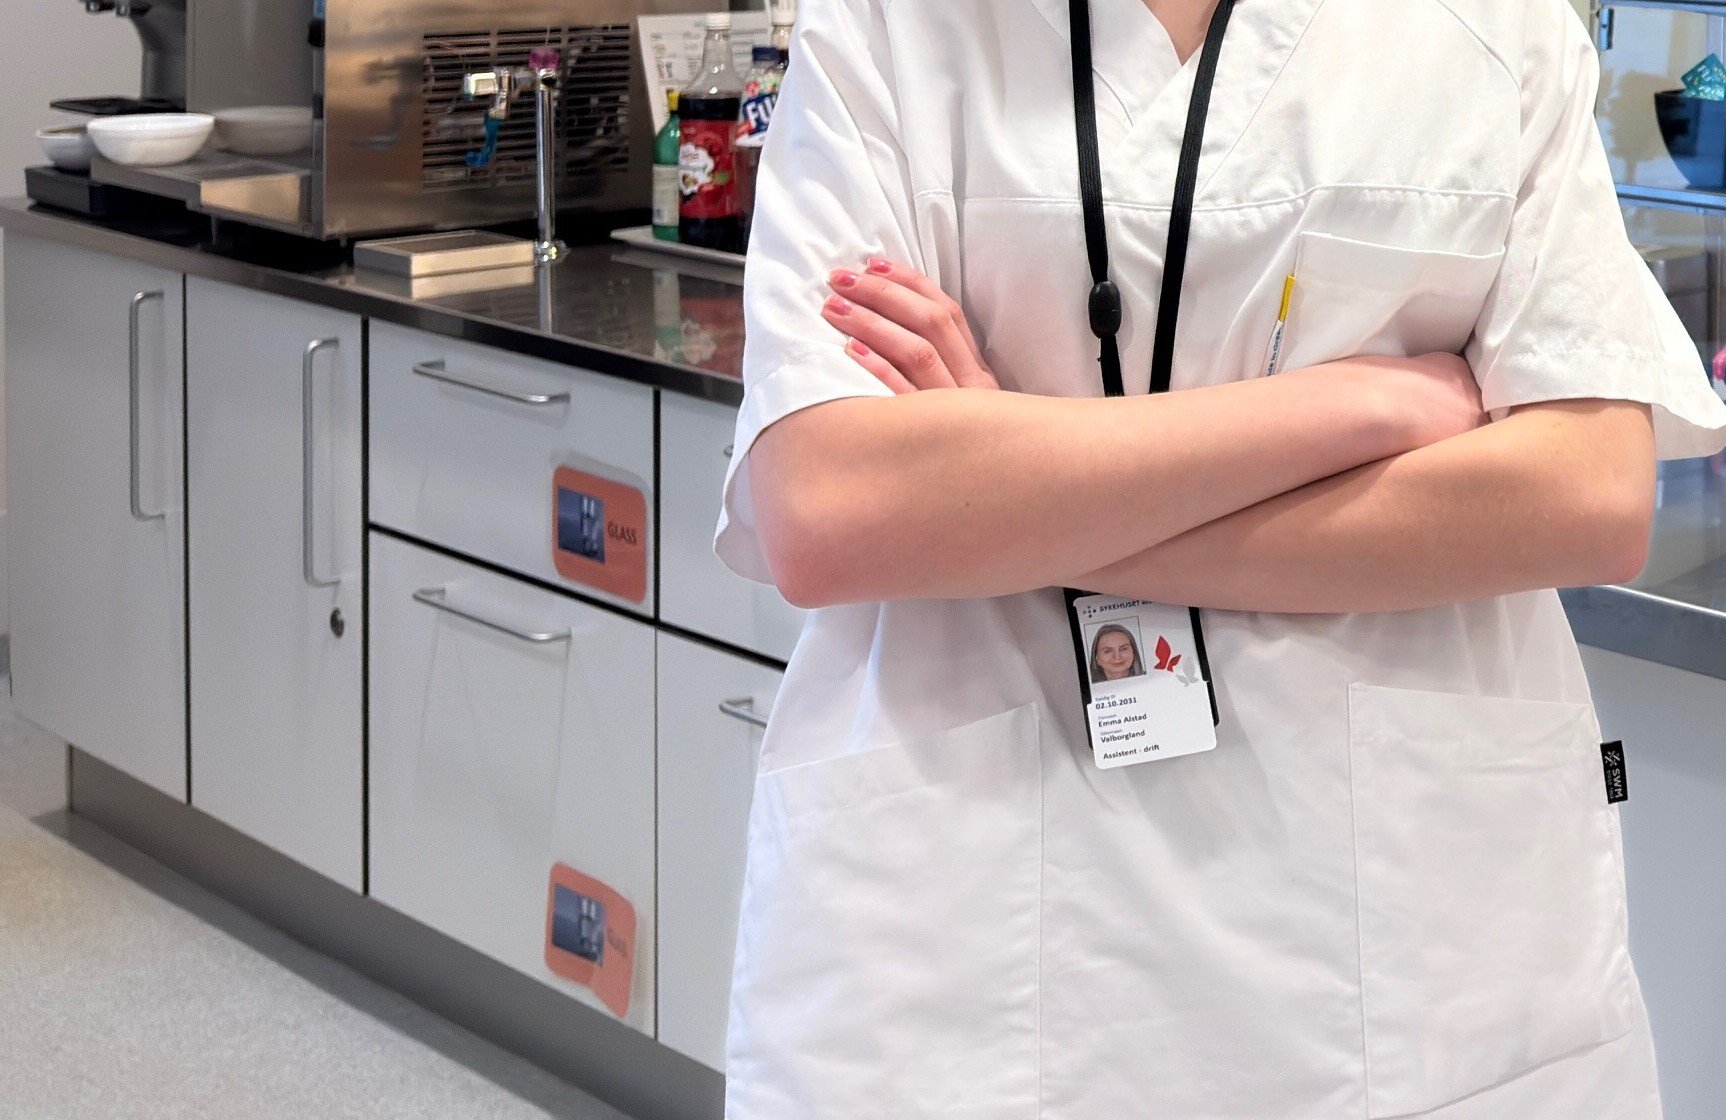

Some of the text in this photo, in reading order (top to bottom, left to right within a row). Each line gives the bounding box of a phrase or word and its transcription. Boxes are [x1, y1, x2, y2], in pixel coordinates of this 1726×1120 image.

[744, 93, 779, 130] FU
[1095, 696, 1137, 710] 02.10.2031
[1098, 718, 1122, 729] Emma
[1124, 714, 1147, 725] Alstad
[1100, 730, 1146, 744] Valborgland
[1103, 744, 1160, 760] Assistent drift
